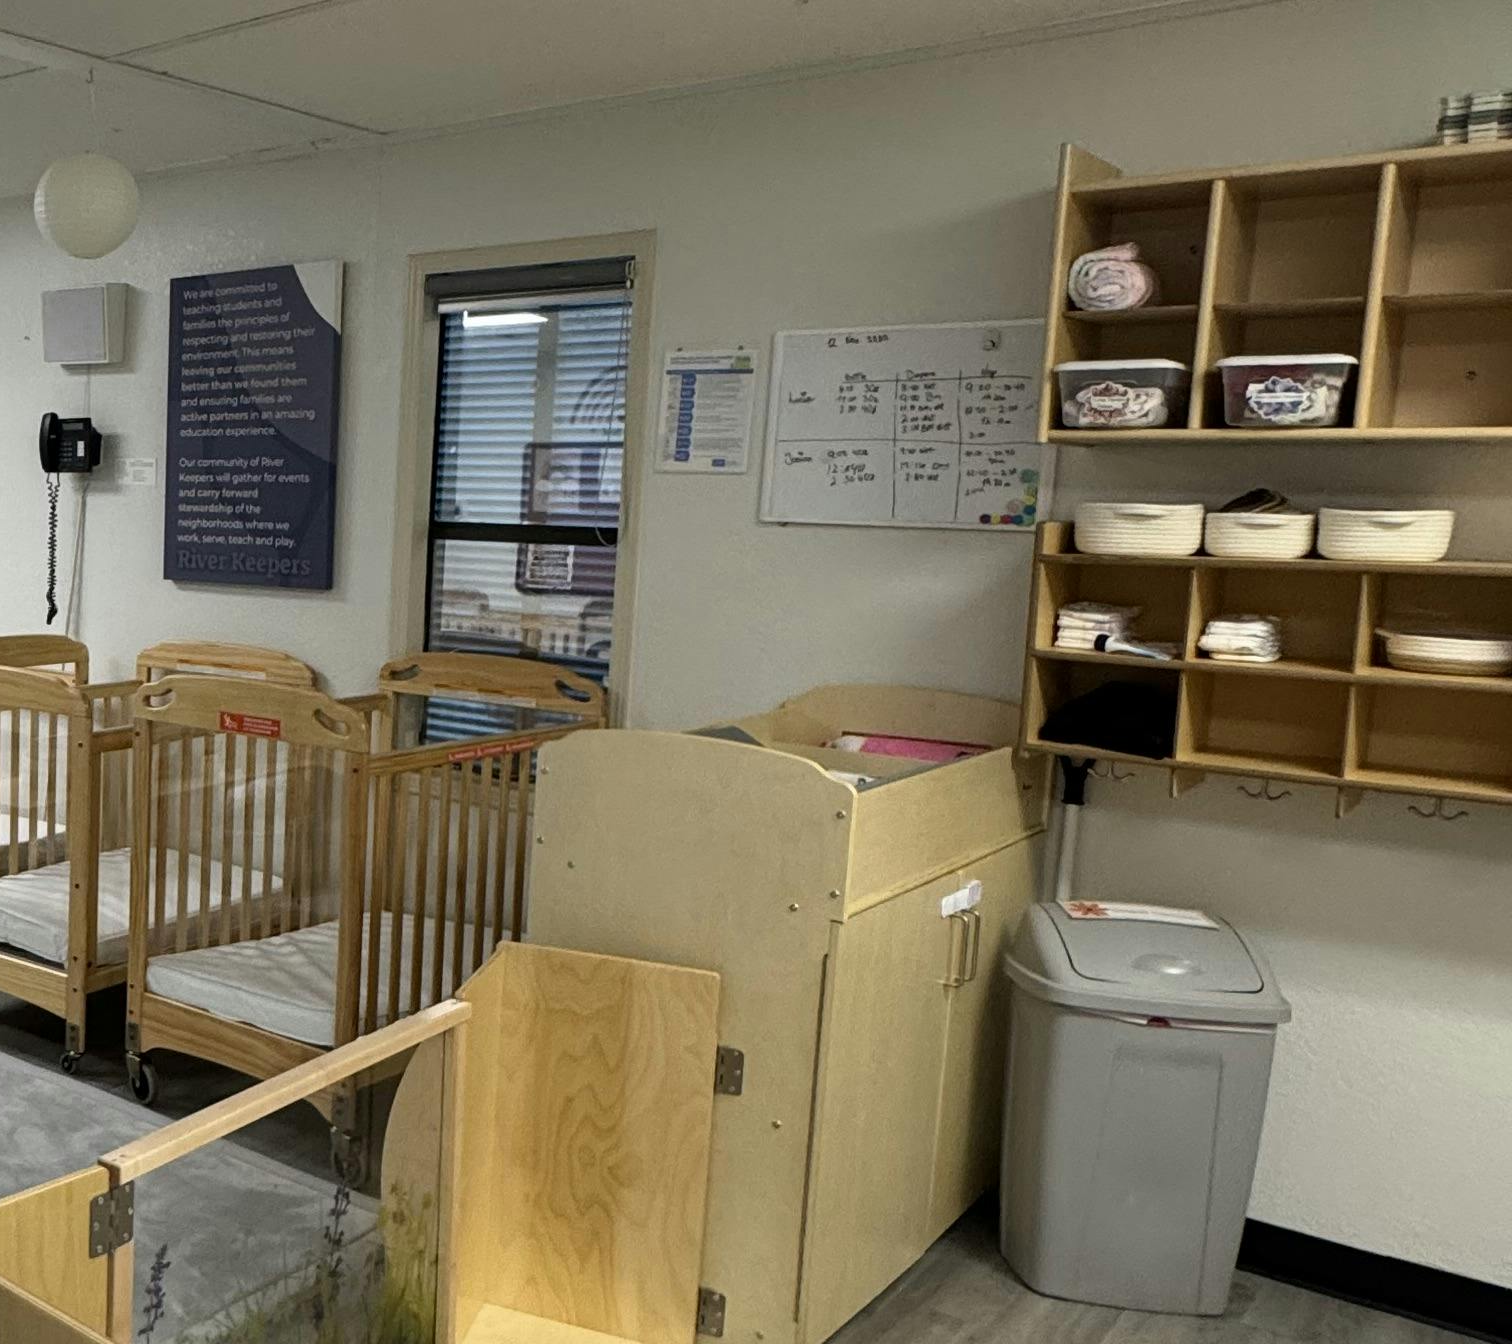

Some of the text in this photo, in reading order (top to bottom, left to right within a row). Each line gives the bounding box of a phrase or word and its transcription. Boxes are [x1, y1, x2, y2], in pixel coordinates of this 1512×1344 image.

[184, 282, 278, 300] We are committed to
[183, 296, 282, 315] teaching students and
[183, 312, 291, 330] families the principles of
[182, 327, 315, 347] respecting and restoring their
[241, 347, 260, 357] This
[262, 345, 294, 355] means
[182, 361, 296, 376] leaving our communities
[181, 377, 307, 392] better than we found them
[181, 394, 293, 407] and ensuring families are
[180, 409, 316, 423] active partners in an amazing
[180, 427, 224, 437] education
[178, 457, 284, 469] Our community of River
[178, 473, 310, 485] Keepers will gather for events
[178, 488, 258, 499] and carry forward
[178, 503, 261, 514] stewardship of the
[178, 519, 290, 530] neighborhoods where we
[228, 535, 254, 545] teach
[255, 535, 273, 546] and
[275, 536, 296, 549] play.
[178, 549, 312, 578] River Keepers
